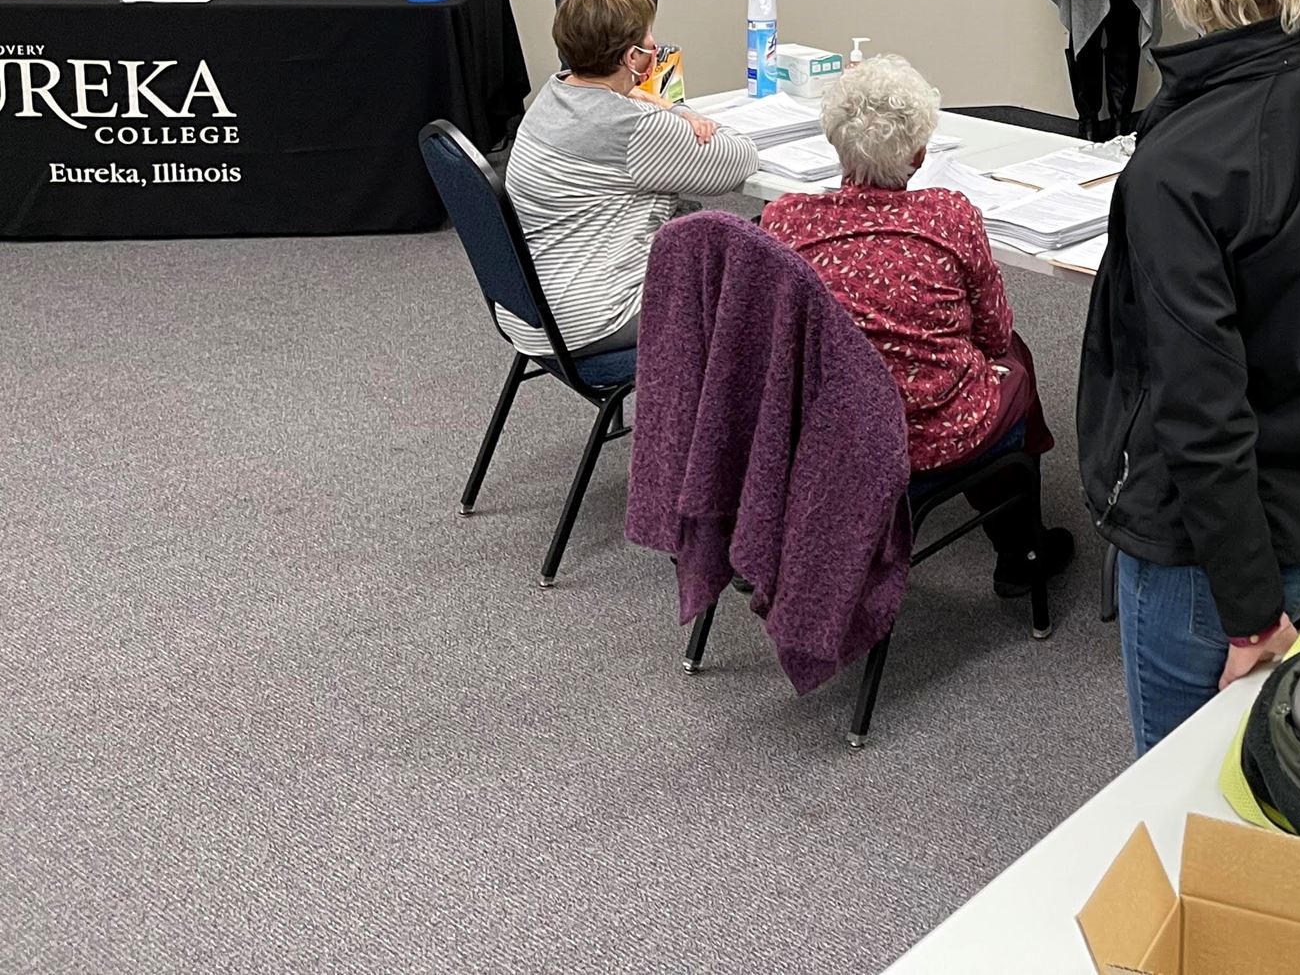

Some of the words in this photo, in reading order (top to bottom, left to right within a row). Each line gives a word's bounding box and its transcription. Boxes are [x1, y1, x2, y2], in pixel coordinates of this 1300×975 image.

[0, 59, 237, 129] REKA
[95, 126, 240, 145] COLLEGE
[49, 163, 146, 186] Eureka,
[152, 163, 242, 183] Illinois
